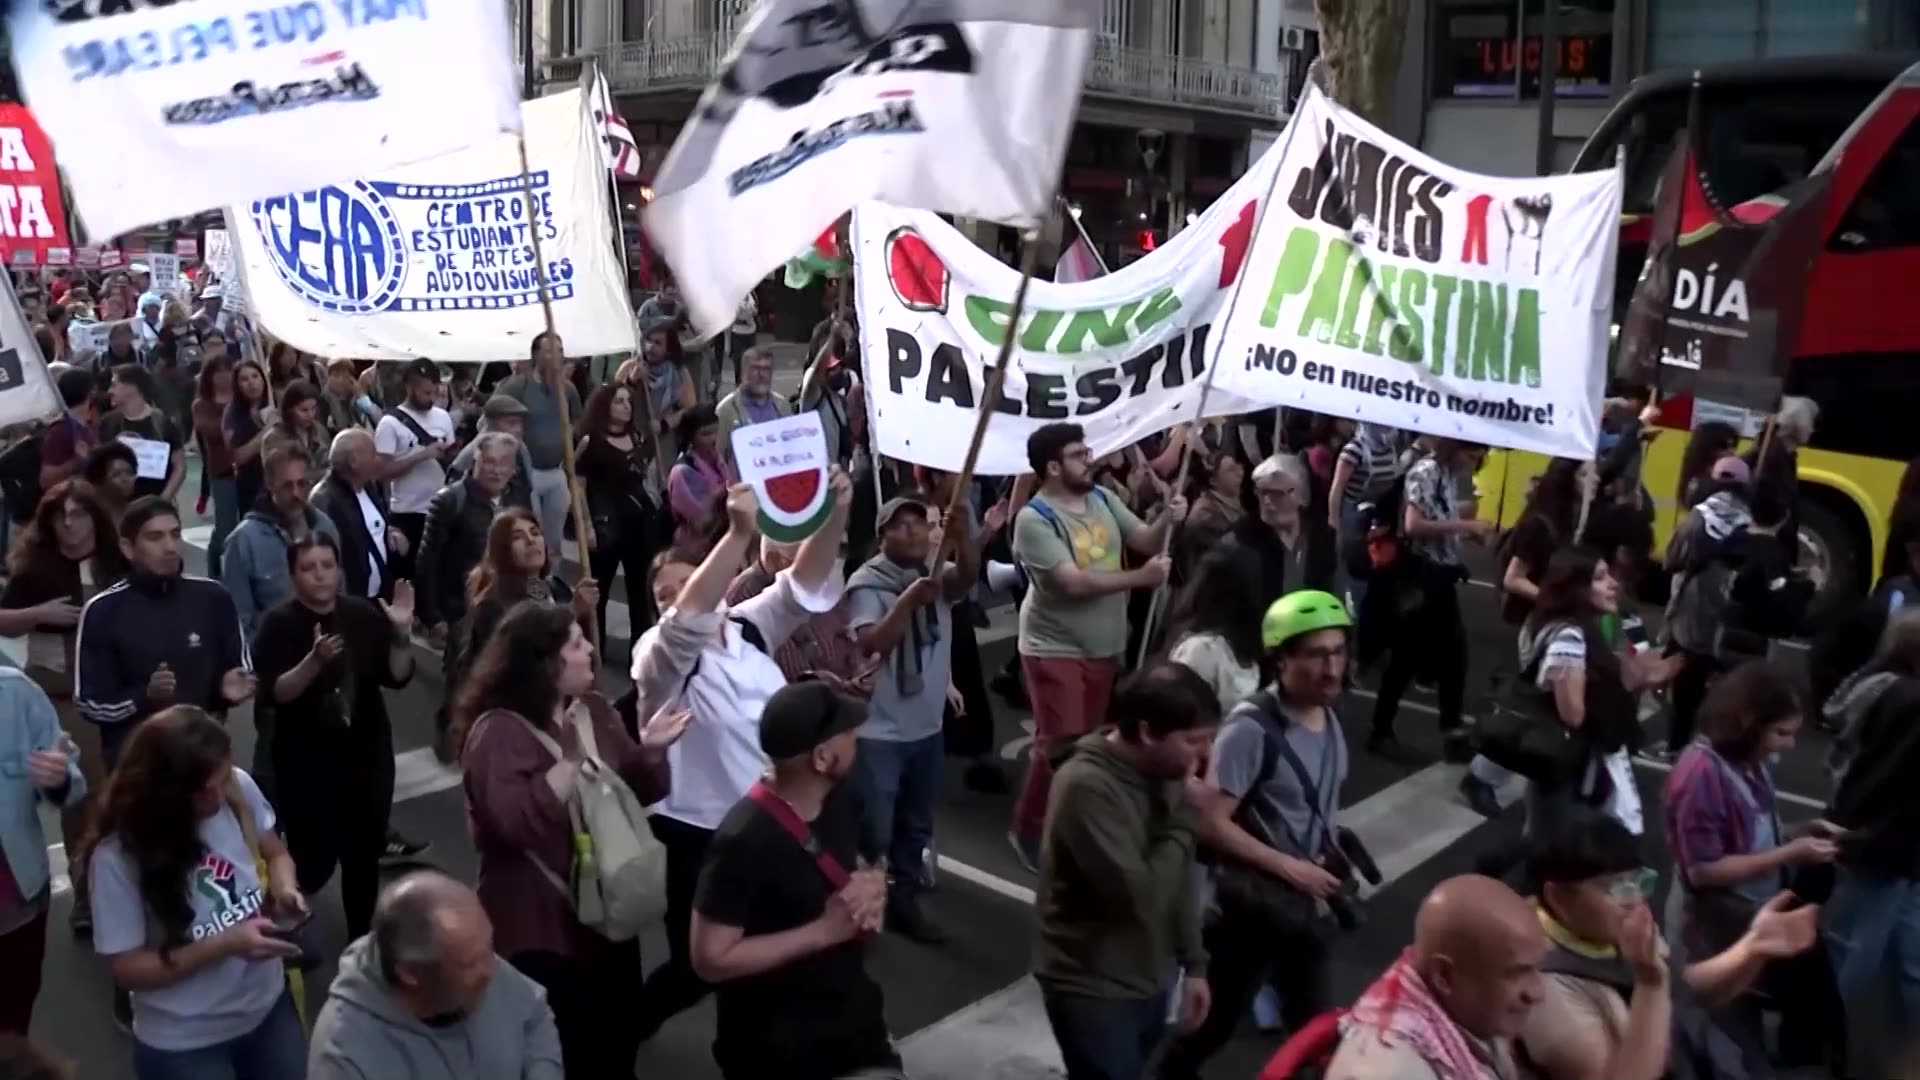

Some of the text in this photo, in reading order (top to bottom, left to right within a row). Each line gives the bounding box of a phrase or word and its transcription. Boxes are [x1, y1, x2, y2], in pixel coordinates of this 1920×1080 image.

[427, 198, 522, 227] CENTRO
[436, 245, 535, 271] DE ARTES
[1259, 227, 1541, 388] PALESTINA
[1672, 262, 1749, 322] DÍA
[1245, 343, 1554, 425] ¡NO en nuestro nombre!
